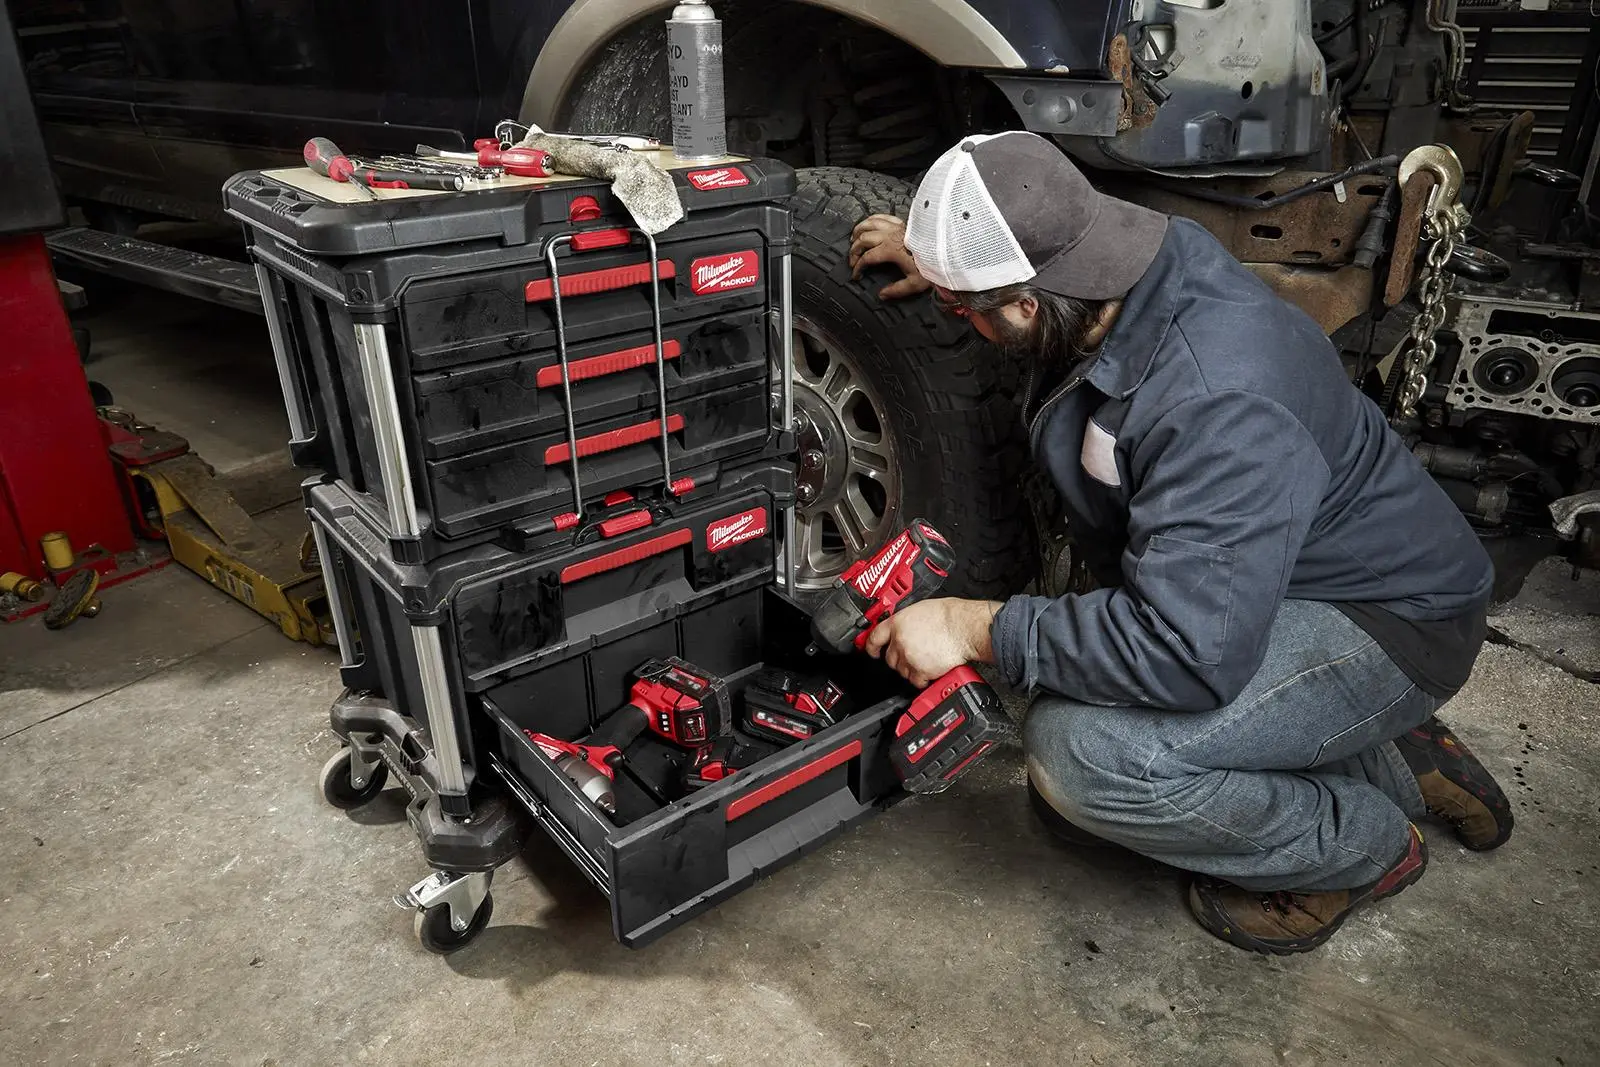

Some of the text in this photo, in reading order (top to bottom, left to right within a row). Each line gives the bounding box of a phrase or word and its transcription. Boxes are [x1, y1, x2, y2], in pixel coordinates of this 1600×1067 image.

[667, 44, 682, 59] YD
[692, 170, 730, 185] Milwaukee
[695, 256, 744, 285] Milwaukee
[720, 275, 756, 288] PACKOUT
[710, 514, 754, 544] Milwaukee
[732, 527, 764, 542] PACKOUT
[855, 535, 908, 595] Milwaukee
